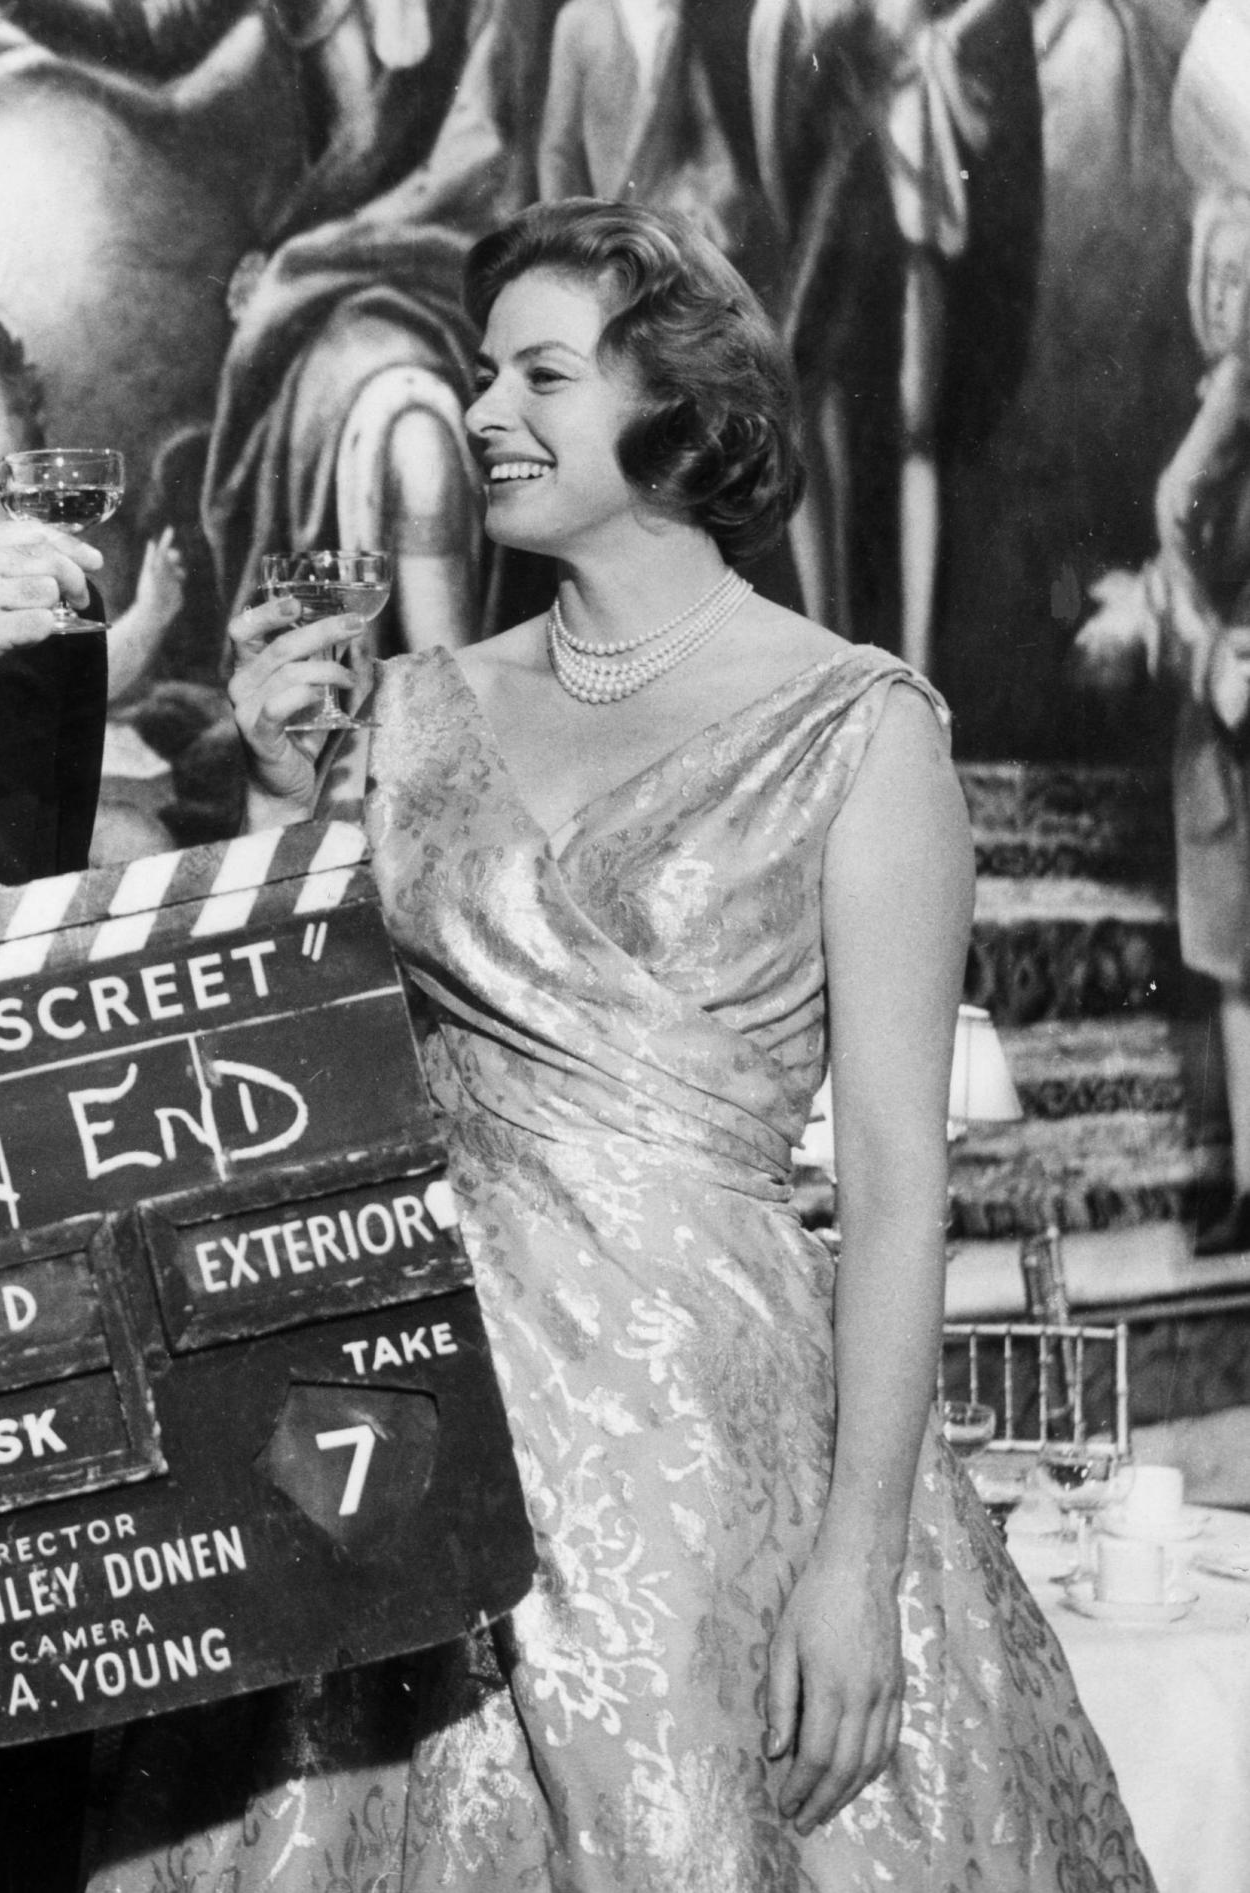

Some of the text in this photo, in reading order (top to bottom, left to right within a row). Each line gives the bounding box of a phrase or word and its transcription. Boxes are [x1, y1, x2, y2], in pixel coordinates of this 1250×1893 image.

[195, 1195, 435, 1293] EXTERIOR
[341, 1322, 459, 1376] TAKE
[314, 1423, 376, 1516] 7
[102, 1525, 248, 1600] DONEN
[9, 1612, 156, 1664] CAMERA
